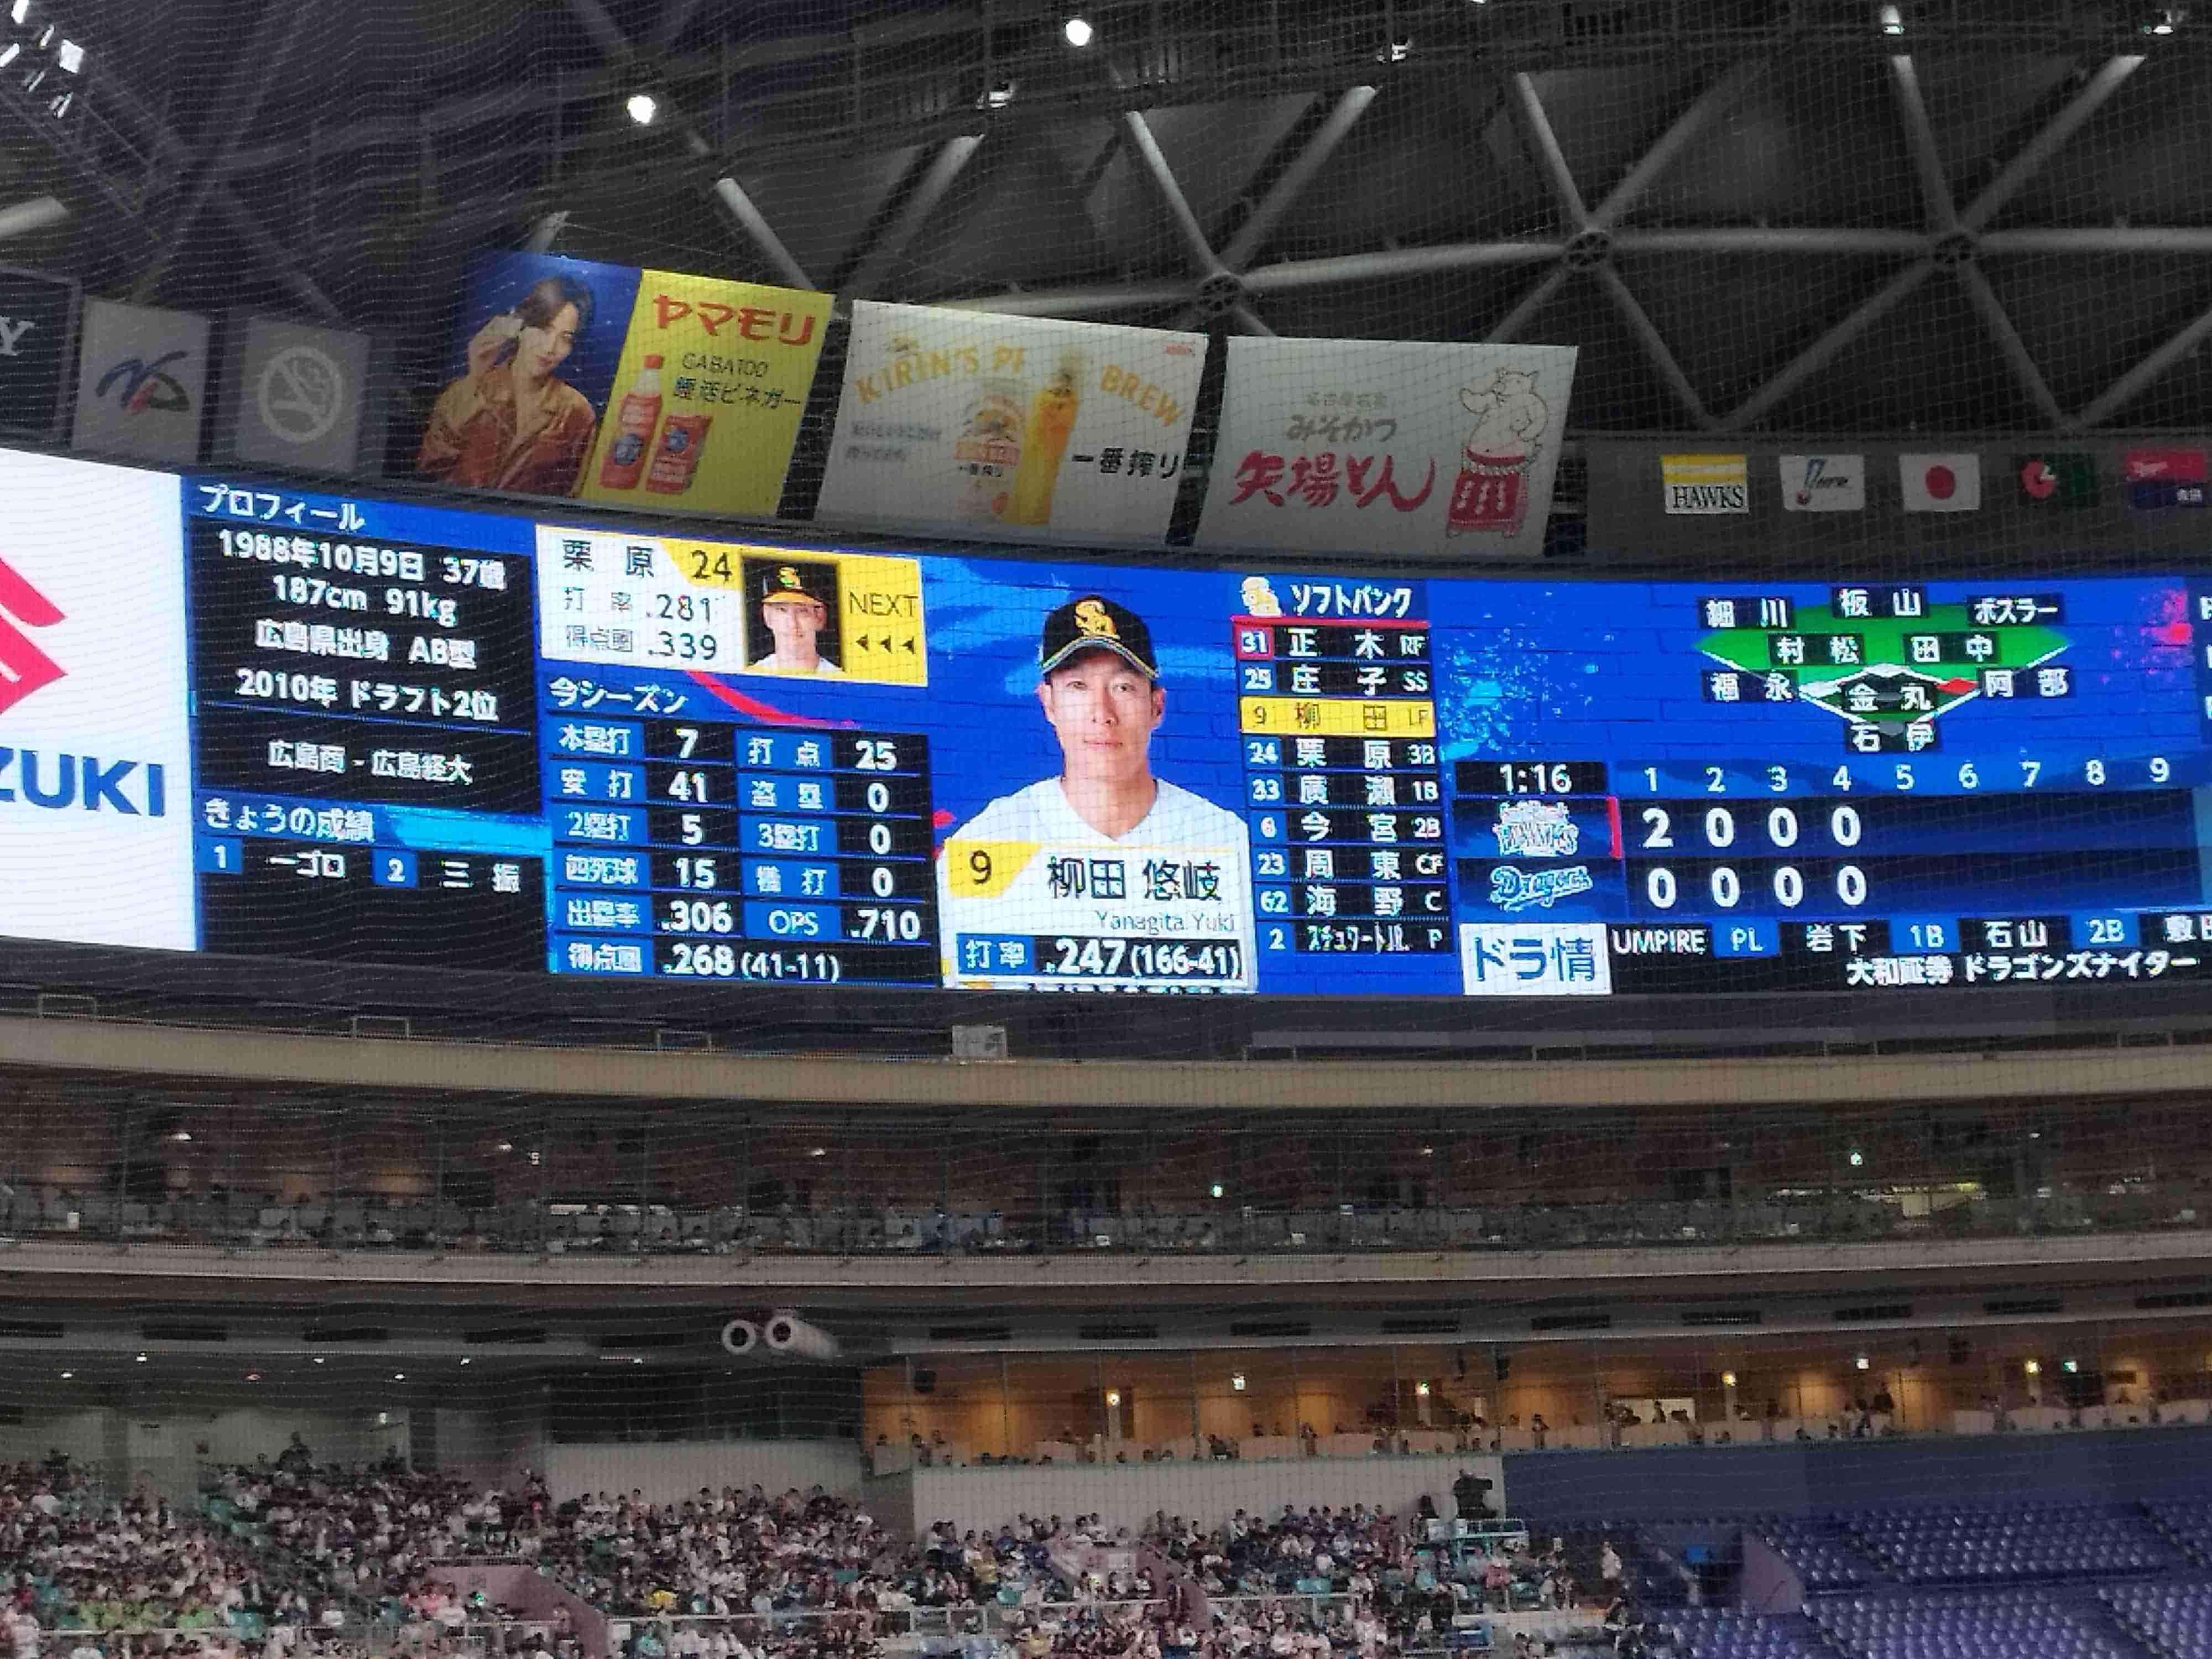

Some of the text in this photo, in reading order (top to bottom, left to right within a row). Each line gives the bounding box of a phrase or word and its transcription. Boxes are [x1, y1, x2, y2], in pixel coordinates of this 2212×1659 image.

[653, 294, 815, 346] ヤマモリ
[853, 344, 979, 404] KIRIN'S
[1099, 363, 1187, 426] BREW
[1287, 415, 1397, 443] みそかつ
[1072, 447, 1179, 479] 一番搾り
[1228, 450, 1436, 512] 矢場とん
[1673, 486, 1744, 508] HAWKS
[200, 484, 366, 530] プロフィール
[220, 529, 507, 591] 1988年10月9日 37歳
[691, 550, 733, 582] 24
[273, 574, 457, 627] 187cm 91kg
[646, 593, 712, 621] .281
[848, 591, 919, 618] NEXT
[1290, 584, 1412, 618] ソフトバンク
[1974, 598, 2058, 625] ボスラー
[255, 619, 477, 670] 広島県出身 AB型
[648, 631, 717, 659] .339
[1240, 631, 1268, 654] 31
[236, 669, 499, 721] 2010年 ドラフト2位
[549, 677, 689, 713] 今シーズン
[1403, 670, 1428, 691] SS
[1254, 706, 1266, 724] 9
[558, 723, 630, 755] 本塁打
[675, 728, 698, 758] 7
[855, 740, 898, 770] 25
[1248, 742, 1279, 764] 24
[0, 746, 165, 817] UKI
[668, 772, 708, 804] 41
[867, 782, 889, 813] 0
[1413, 780, 1438, 802] 1B
[1499, 763, 1572, 794] 1:16
[1644, 758, 2170, 792] 1 2 3 4 5 6 7 8 9
[203, 801, 374, 841] きょうの成績
[566, 811, 891, 855] 2塁打 5 3塁打 0
[1641, 806, 1861, 848] 2 0 0 0
[215, 846, 227, 868] 1
[388, 860, 405, 883] 2
[565, 854, 639, 884] 四死球
[675, 857, 717, 889] 15
[872, 867, 893, 898] 0
[969, 850, 992, 884] 9
[1257, 852, 1285, 875] 23
[1415, 853, 1444, 874] CF
[1260, 890, 1288, 912] 62
[1425, 891, 1442, 911] C
[1647, 865, 1867, 908] 0 0 0 0
[566, 899, 921, 941] 出塁率 .306 OPS .710
[1095, 910, 1235, 935] Yanagita Yuki
[965, 940, 1027, 969] 打率
[1269, 927, 1286, 950] 2
[1427, 928, 1443, 950] P
[1612, 928, 1708, 956] UMPIRE
[1730, 927, 1765, 952] PL
[1806, 924, 1867, 952] 岩下
[1910, 925, 1945, 949] 1B
[2089, 920, 2125, 943] 2B
[1474, 936, 1595, 982] ドラ情
[1846, 950, 2199, 987] 大和証券 ドラゴンズナイター
